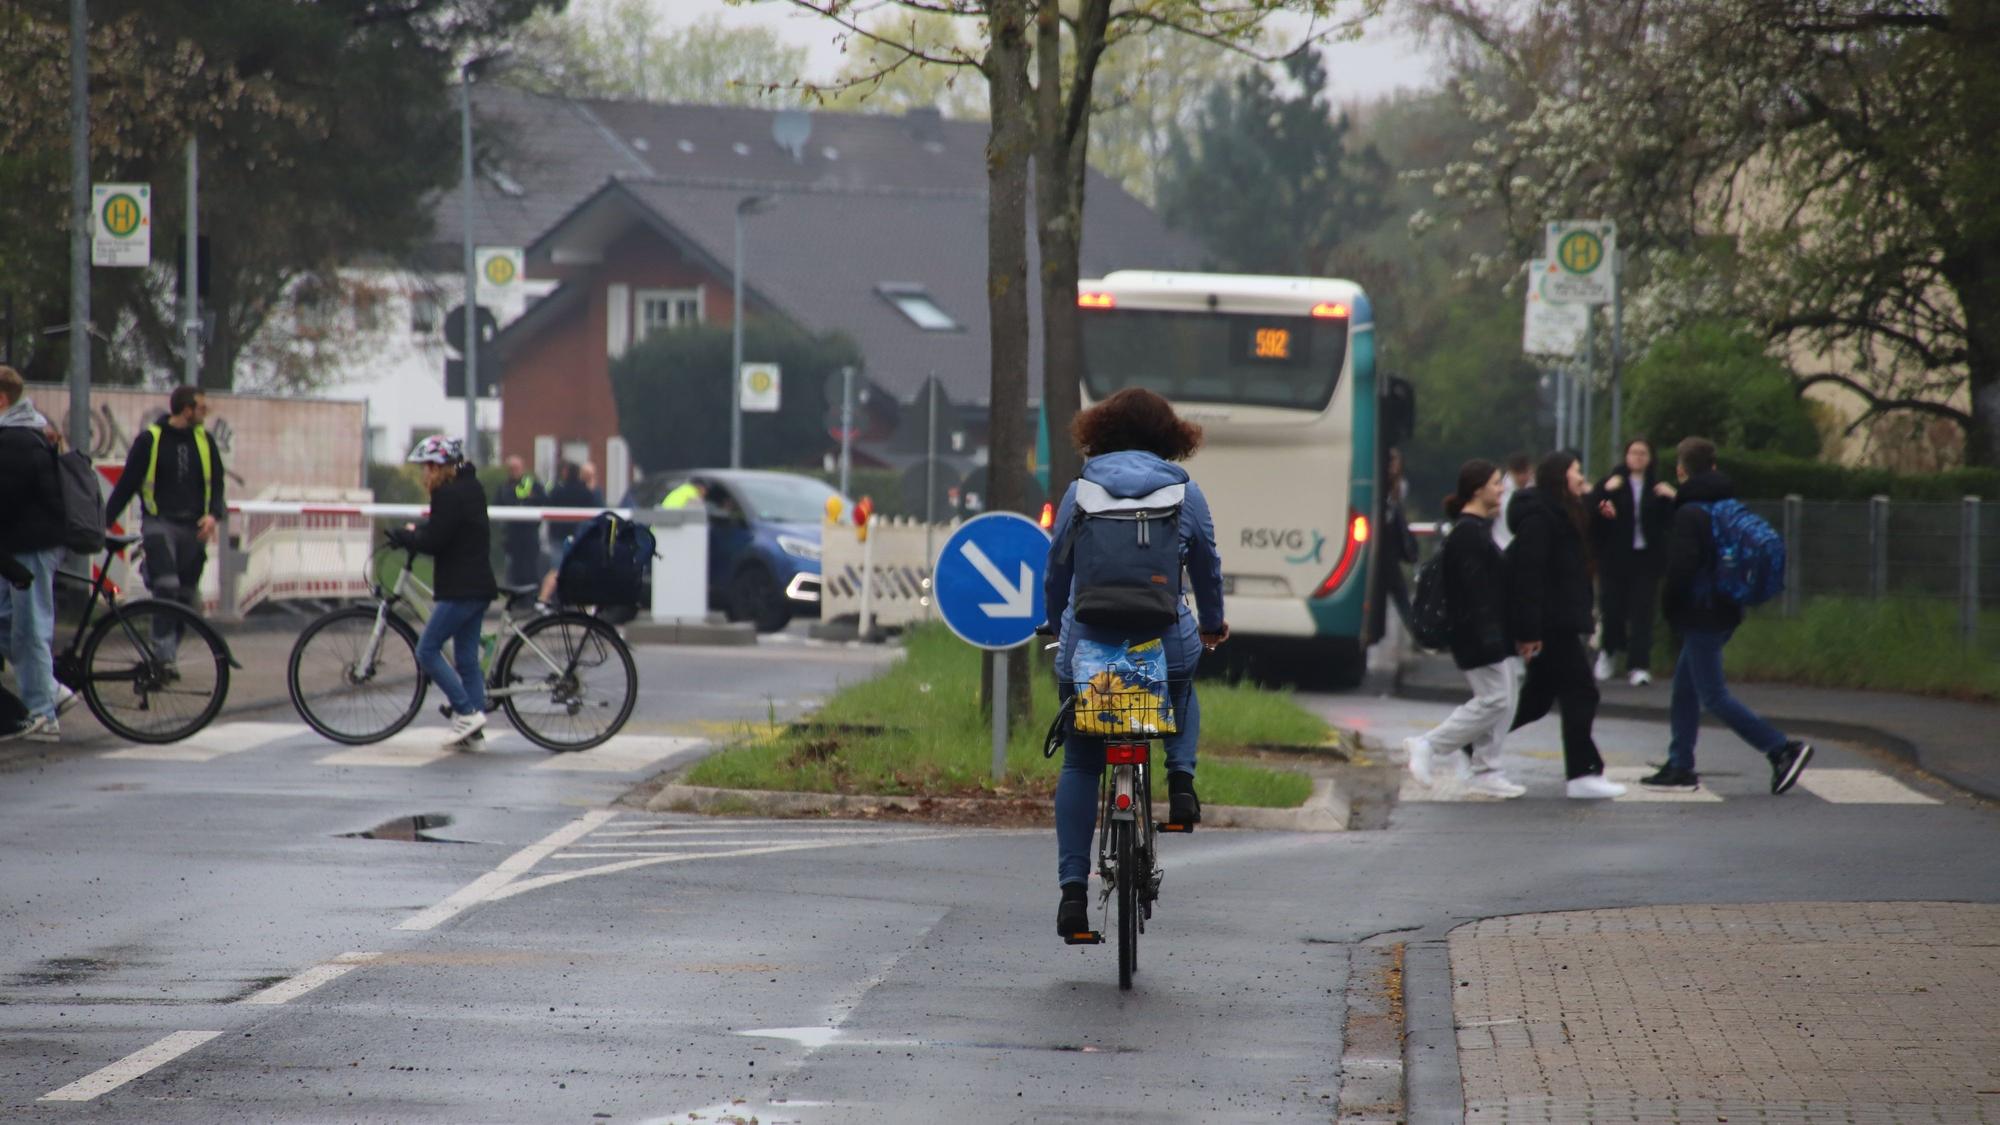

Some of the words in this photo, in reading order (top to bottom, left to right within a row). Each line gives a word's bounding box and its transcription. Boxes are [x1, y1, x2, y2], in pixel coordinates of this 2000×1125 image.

[113, 202, 129, 228] H
[1570, 239, 1591, 267] H
[1256, 328, 1289, 357] 592
[1240, 527, 1302, 549] RSVG
